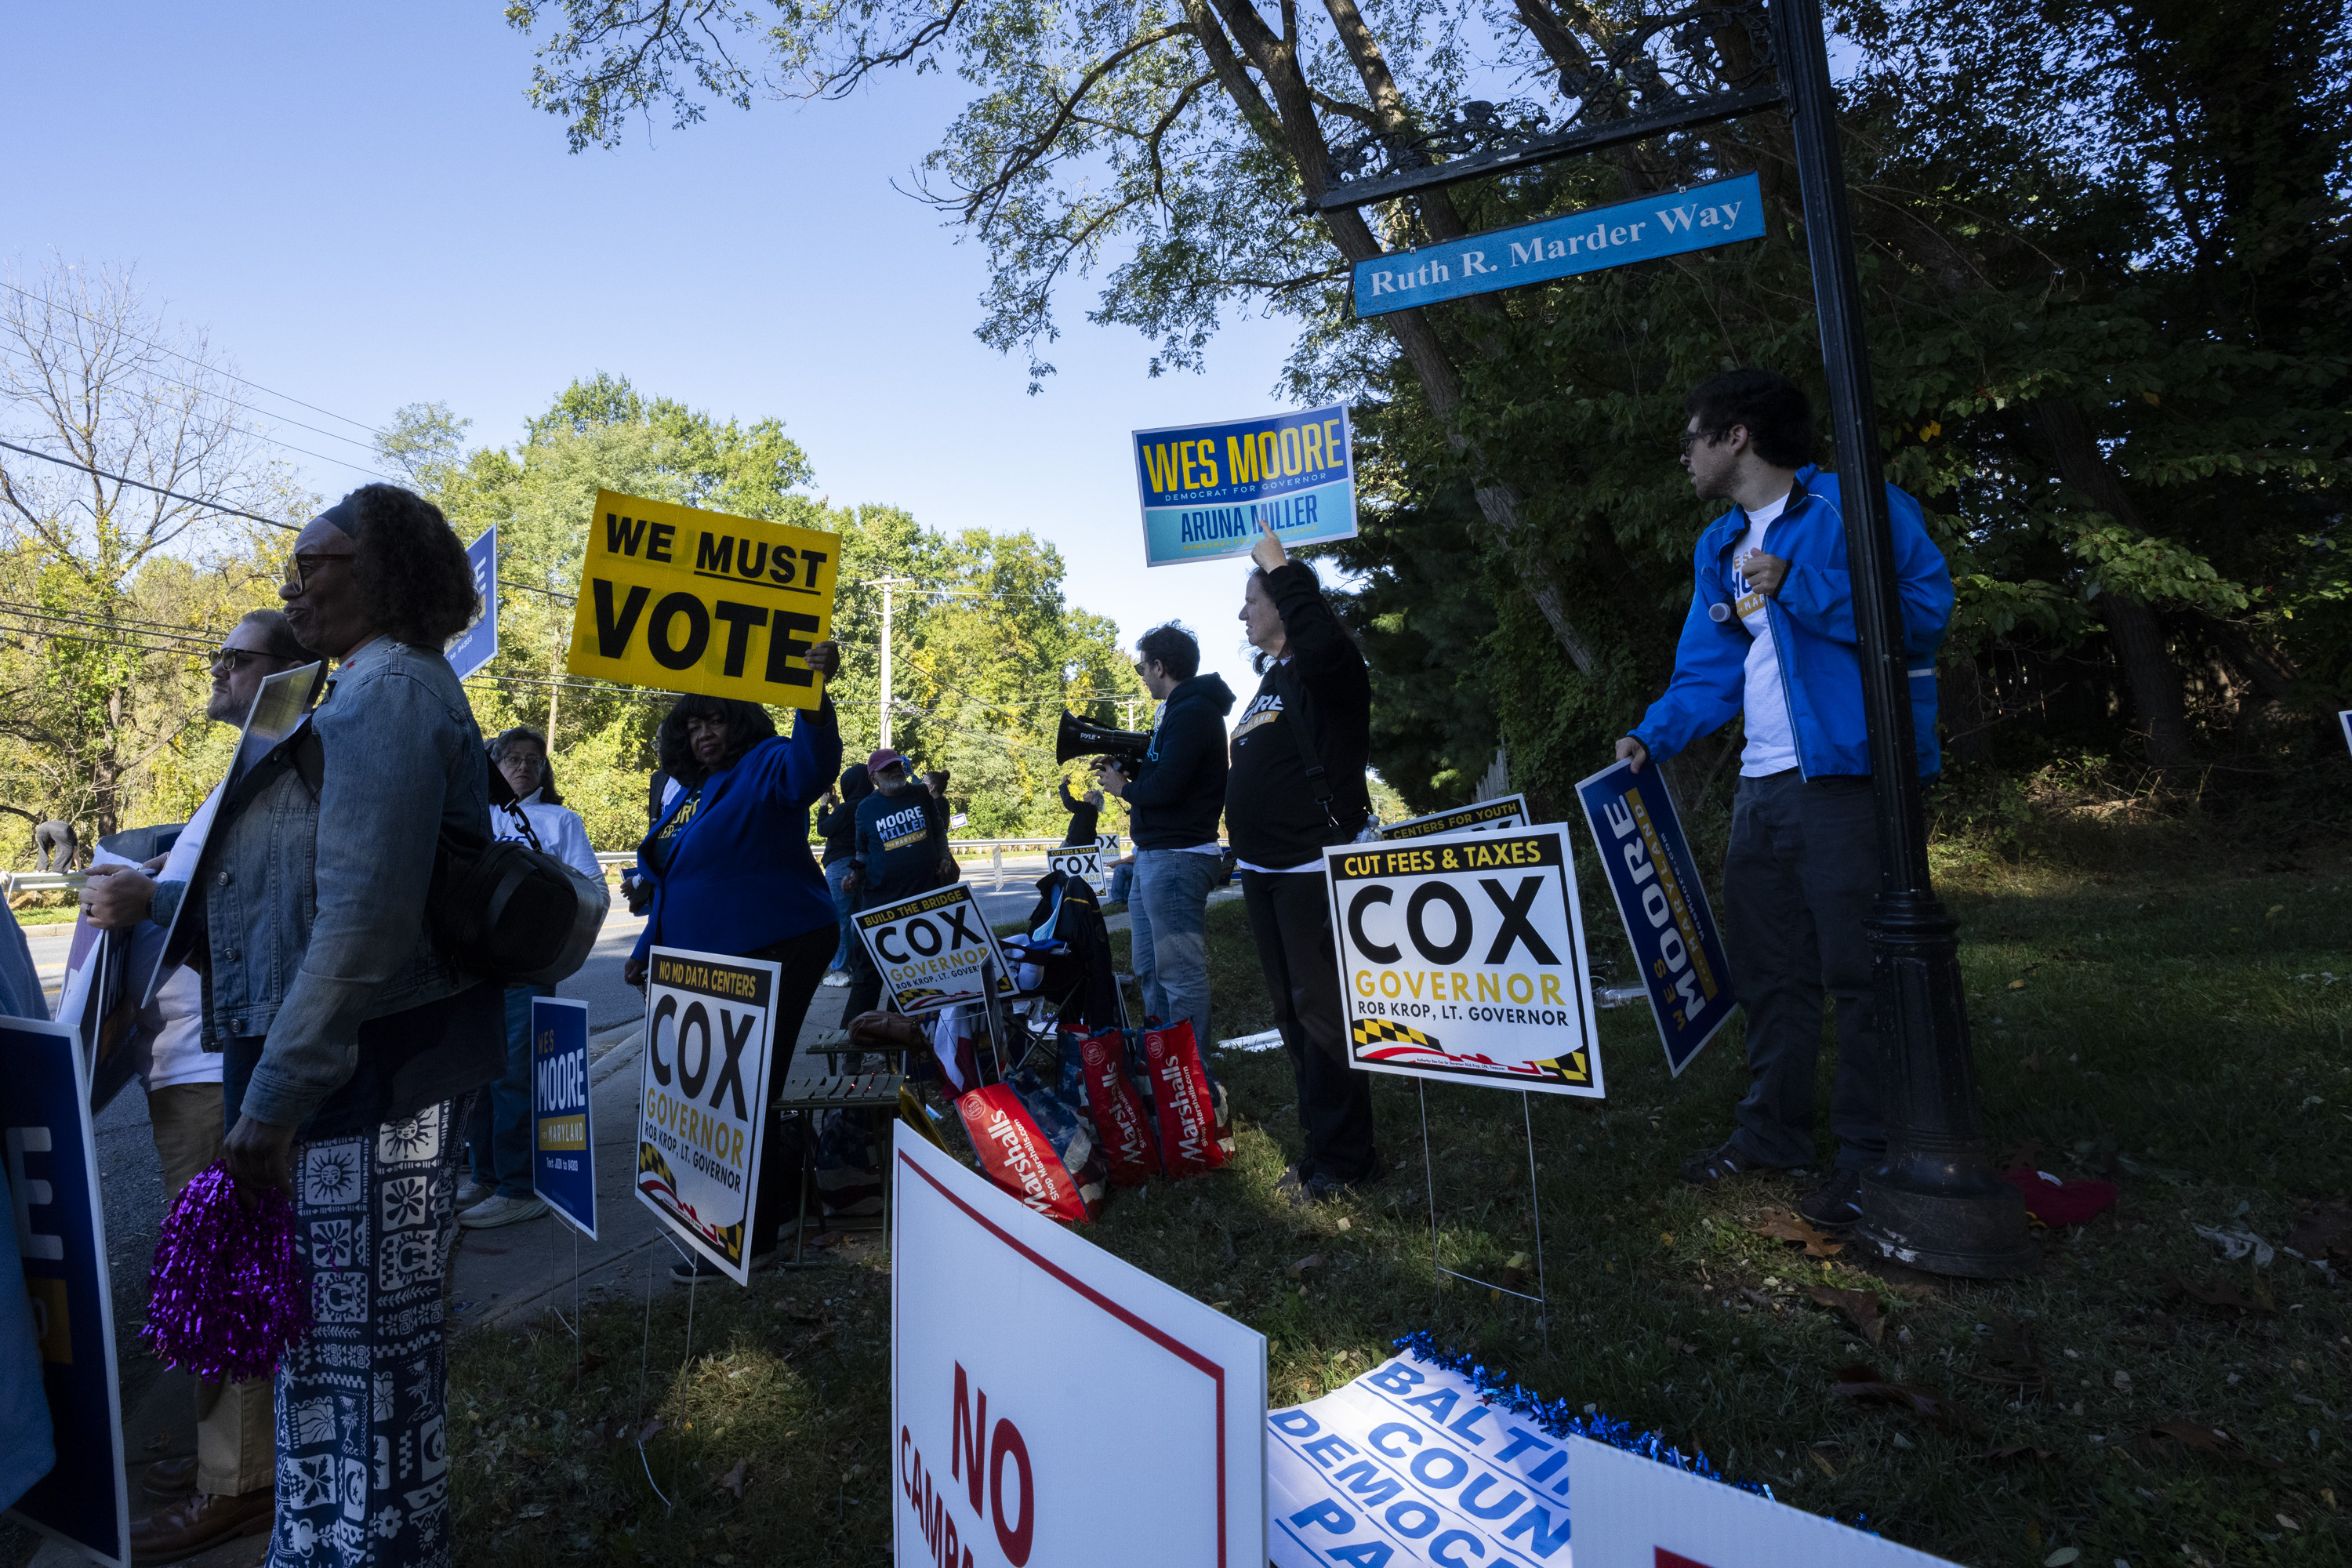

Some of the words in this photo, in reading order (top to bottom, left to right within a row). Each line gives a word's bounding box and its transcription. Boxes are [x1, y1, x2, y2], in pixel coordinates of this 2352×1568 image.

[1370, 260, 1450, 297] Ruth
[1461, 251, 1498, 278] R.
[1509, 221, 1646, 268] Marder
[1655, 201, 1744, 236] Way
[1143, 439, 1219, 493] WES
[1227, 419, 1345, 485] MOORE
[1165, 488, 1227, 502] DEMOCRAT
[1233, 485, 1256, 495] FOR
[1262, 473, 1327, 491] GOVERNOR
[1181, 507, 1247, 543] ARUNA
[1250, 494, 1319, 535] MILLER
[1182, 540, 1230, 551] DEMOCRAT
[1234, 538, 1251, 546] FOR
[1276, 525, 1318, 538] OVERNOR
[607, 513, 677, 563] WE
[696, 531, 828, 588] MUST
[458, 635, 473, 653] 84303
[593, 577, 821, 688] VOTE
[876, 806, 924, 833] MOORE
[879, 818, 927, 843] MILLER
[895, 831, 926, 846] MARYLAND
[1393, 820, 1445, 840] CENTERS
[1449, 813, 1473, 826] FOR
[1476, 803, 1517, 820] YOUTH
[1052, 855, 1100, 875] COX
[1345, 856, 1381, 876] CUT
[1387, 850, 1435, 873] FEES
[1442, 848, 1460, 869] &
[1464, 840, 1541, 867] TAXES
[1635, 804, 1699, 953] MARYLAND
[864, 909, 895, 927] BUILD
[897, 903, 920, 918] THE
[921, 890, 964, 910] BRIDGE
[1603, 795, 1706, 1021] MOORE
[1661, 833, 1704, 942] wesmoore.com
[875, 905, 985, 964] COX
[1347, 875, 1563, 966] COX
[659, 960, 670, 981] NO
[672, 963, 684, 984] MD
[685, 965, 709, 989] DATA
[711, 969, 757, 999] CENTERS
[895, 979, 913, 990] ROB
[913, 975, 938, 986] KROP,
[938, 971, 949, 981] LT.
[1356, 970, 1566, 1006] GOVERNOR
[1654, 957, 1686, 1032] WES
[1698, 959, 1710, 982] FOR
[1358, 1001, 1386, 1015] ROB
[1390, 1002, 1436, 1021] KROP,
[1442, 1005, 1463, 1020] LT.
[1468, 1007, 1570, 1027] GOVERNOR
[539, 1029, 554, 1055] WES
[651, 993, 757, 1123] COX
[538, 1047, 585, 1112] MOORE
[1182, 1065, 1206, 1126] Marshalls.com
[549, 1122, 583, 1142] MARYLAND
[647, 1087, 744, 1170] GOVERNOR
[1161, 1054, 1206, 1163] Marshalls
[645, 1121, 657, 1142] ROB
[659, 1130, 678, 1159] KROP,
[681, 1143, 690, 1163] LT.
[693, 1151, 741, 1194] GOVERNOR
[1014, 1119, 1048, 1178] Marshalls.com
[1200, 1126, 1208, 1147] Shop
[988, 1109, 1059, 1218] Marshalls
[1044, 1178, 1060, 1201] Shop
[952, 1359, 1035, 1568] NO
